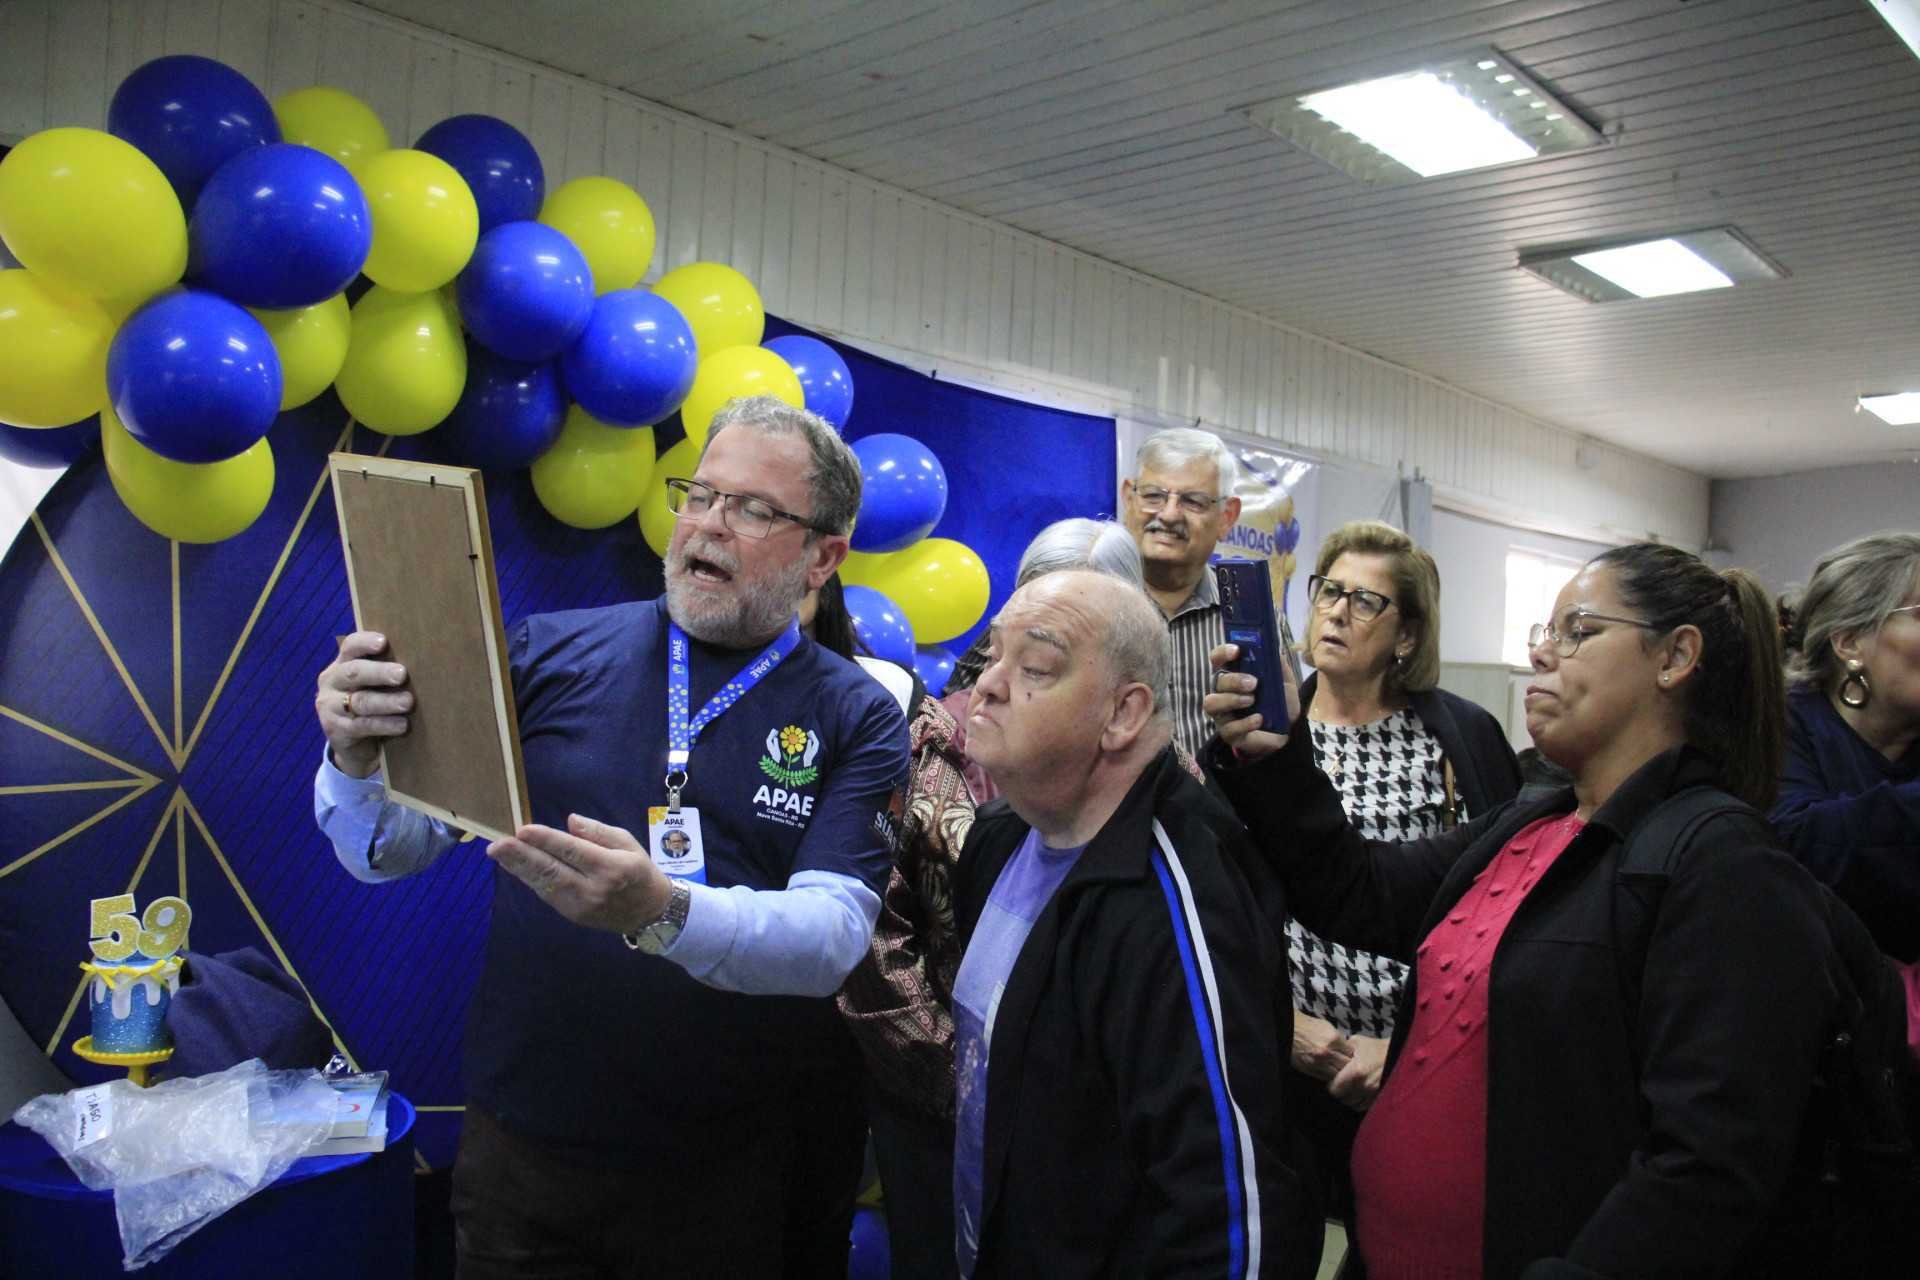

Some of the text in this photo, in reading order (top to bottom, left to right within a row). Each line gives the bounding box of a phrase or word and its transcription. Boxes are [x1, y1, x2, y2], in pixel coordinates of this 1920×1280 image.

[1217, 525, 1273, 556] ANOAS
[673, 639, 682, 662] APAE
[750, 658, 771, 679] APAE
[752, 784, 815, 817] APAE
[664, 818, 685, 826] APAE
[766, 808, 788, 819] CANOAS
[88, 892, 193, 961] 59
